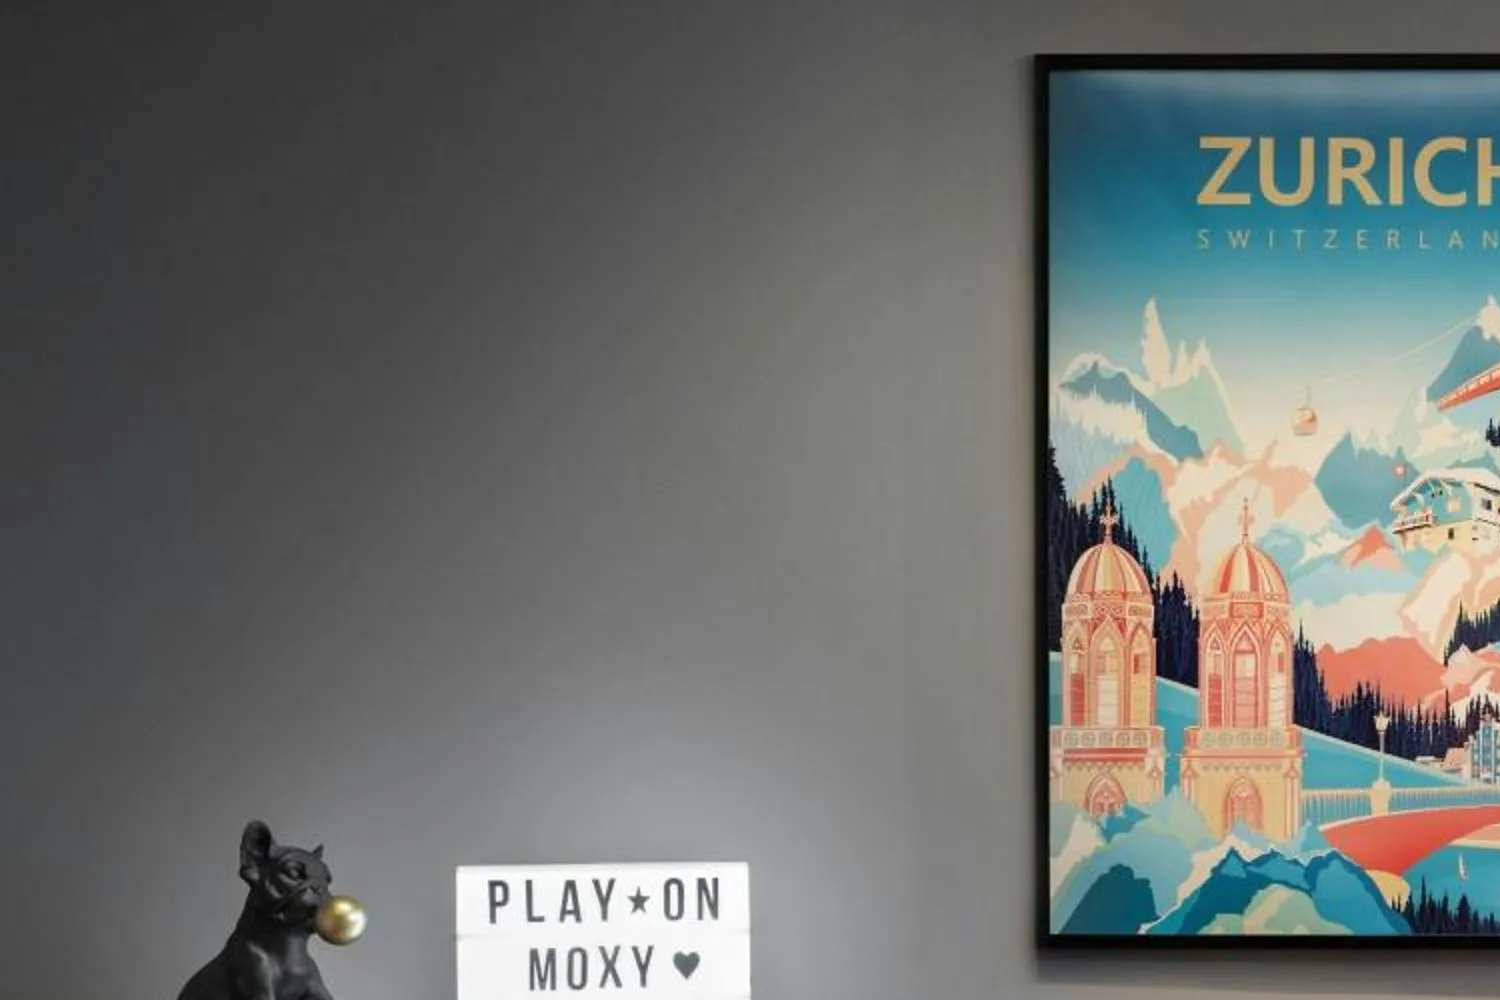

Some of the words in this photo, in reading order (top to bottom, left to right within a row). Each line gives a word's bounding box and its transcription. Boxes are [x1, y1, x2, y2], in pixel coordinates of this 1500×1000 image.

[487, 877, 617, 924] PLAY
[662, 877, 719, 921] ON
[528, 944, 654, 991] MOXY
